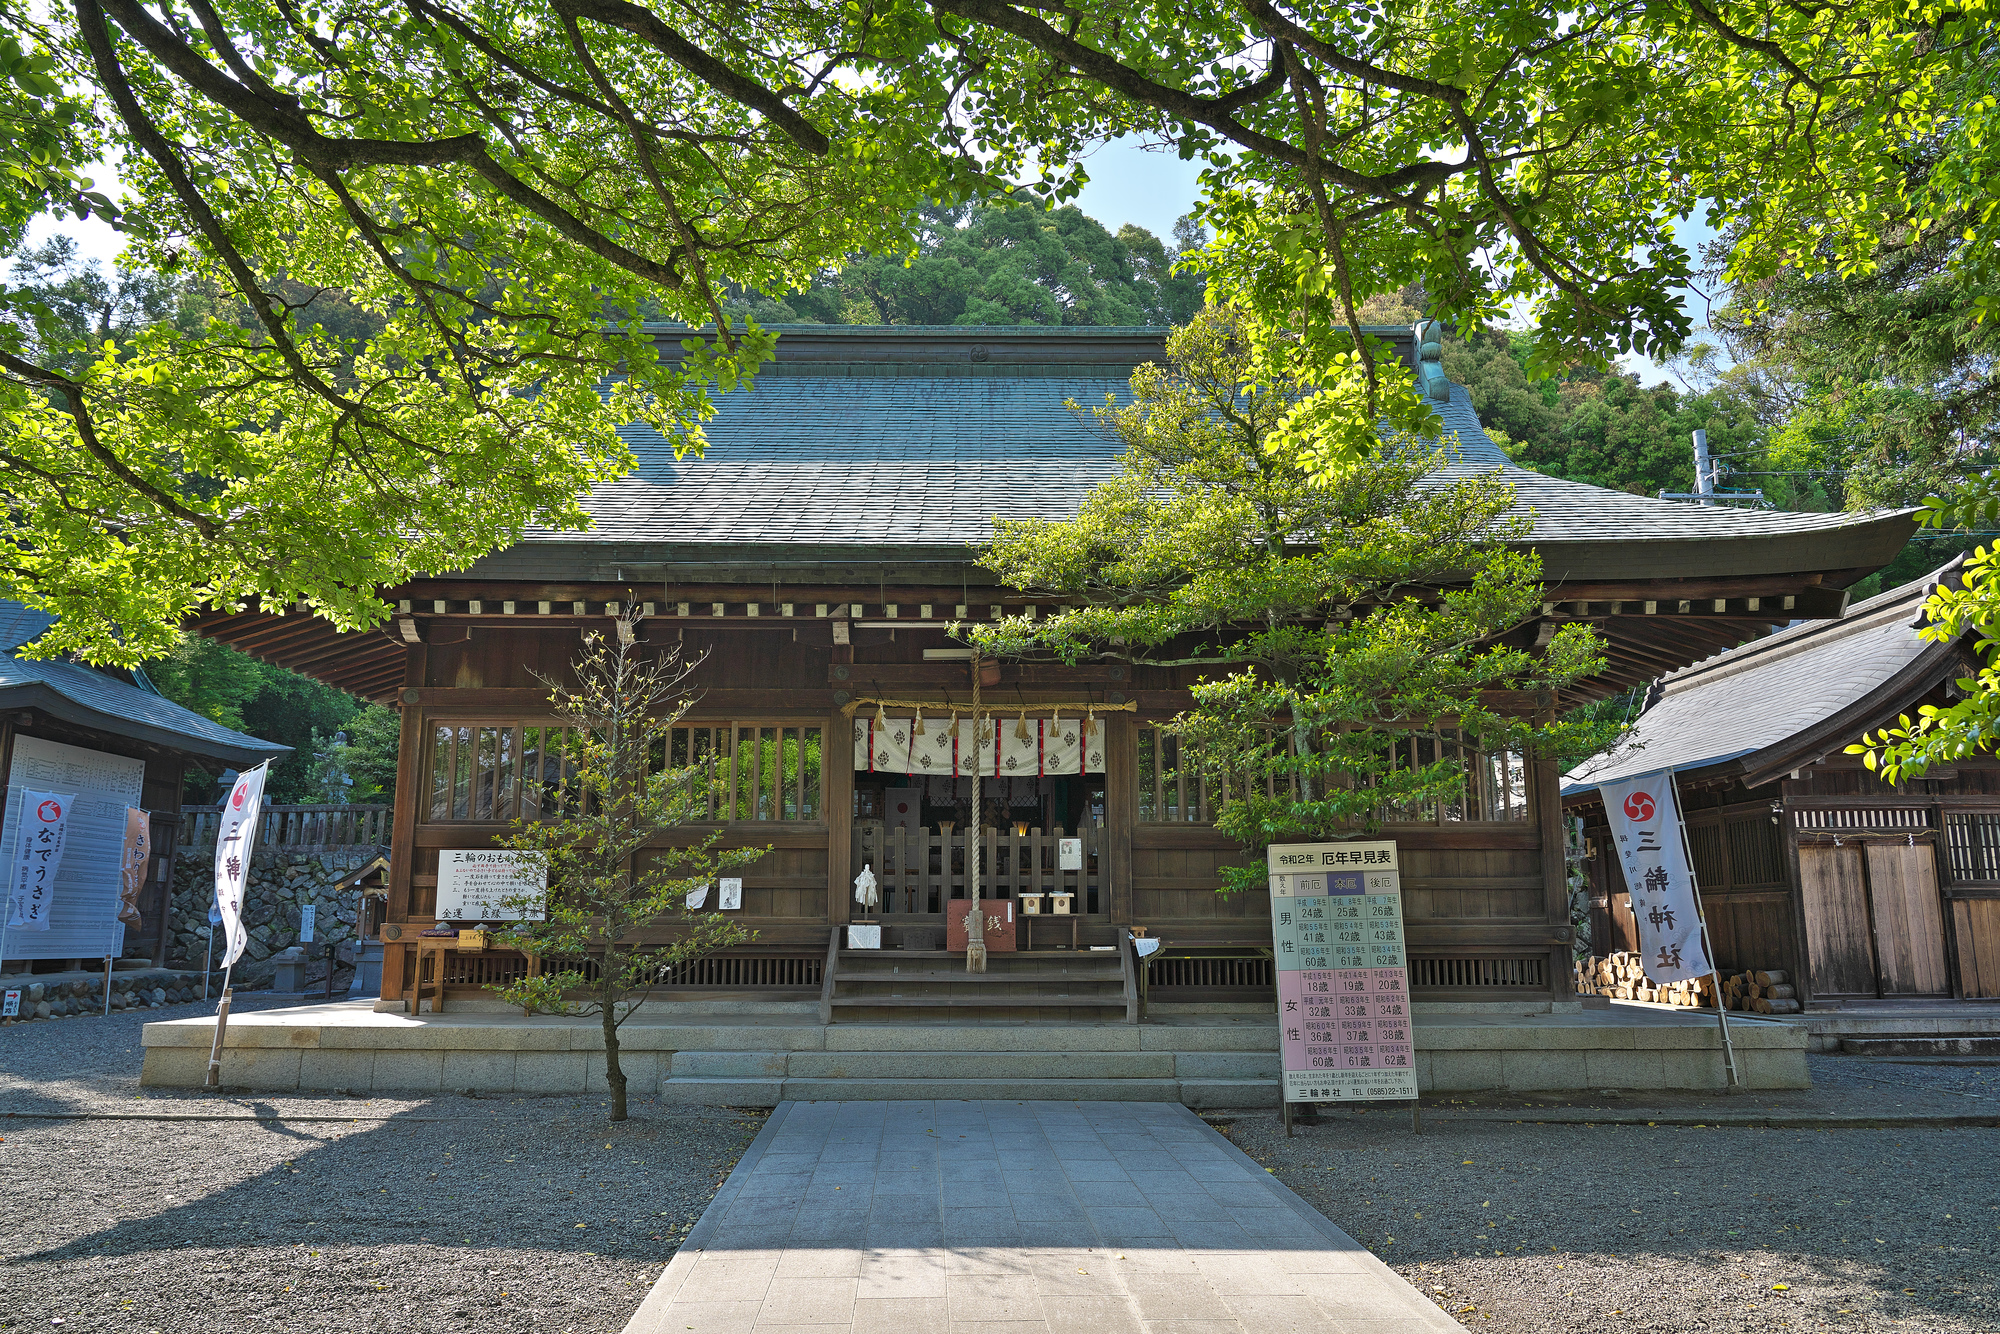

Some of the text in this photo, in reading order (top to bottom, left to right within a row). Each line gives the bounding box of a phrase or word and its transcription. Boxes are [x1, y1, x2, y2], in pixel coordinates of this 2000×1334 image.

[1279, 850, 1392, 866] 令和2年 厄年早見表
[29, 827, 55, 920] なでうさぎ
[1278, 875, 1287, 896] 数え年
[1299, 879, 1322, 891] 前厄
[1334, 877, 1357, 890] 本厄
[1370, 876, 1392, 889] 後厄
[442, 908, 463, 919] 金運
[480, 908, 502, 919] 良縁
[1301, 908, 1324, 919] 24歳
[1337, 907, 1359, 918] 25歳
[1372, 906, 1395, 917] 26歳
[1298, 923, 1330, 931] 昭和55年生
[1334, 922, 1364, 930] 昭和54年生
[1369, 921, 1399, 929] 昭和53年生
[1280, 912, 1295, 954] 男性
[1303, 932, 1326, 943] 41歳
[1338, 931, 1361, 942] 42歳
[1374, 930, 1397, 941] 43歳
[1371, 945, 1401, 953] 昭和34年生
[1305, 957, 1327, 968] 60歳
[1340, 956, 1363, 967] 61歳
[1376, 955, 1399, 966] 62歳
[1302, 972, 1333, 980] 平成15年生
[1338, 970, 1368, 979] 平成14年生
[1373, 969, 1404, 978] 平成13年生
[1307, 982, 1329, 993] 18歳
[1343, 981, 1365, 992] 19歳
[1378, 980, 1401, 990] 20歳
[1308, 1006, 1331, 1017] 32歳
[1344, 1006, 1367, 1016] 33歳
[1380, 1004, 1403, 1015] 34歳
[1284, 998, 1301, 1042] 女性
[1341, 1021, 1372, 1029] 昭和59年生
[1377, 1020, 1408, 1028] 昭和58年生
[1305, 1022, 1336, 1031] 昭和60年生
[1310, 1031, 1333, 1042] 36歳
[1346, 1030, 1369, 1041] 37歳
[1382, 1029, 1405, 1040] 38歳
[1379, 1044, 1410, 1053] 昭和34年生
[1312, 1056, 1335, 1067] 60歳
[1348, 1055, 1371, 1066] 61歳
[1384, 1055, 1407, 1066] 62歳
[1299, 1087, 1414, 1098] 三輪神社 TEL (0585)22-1511
